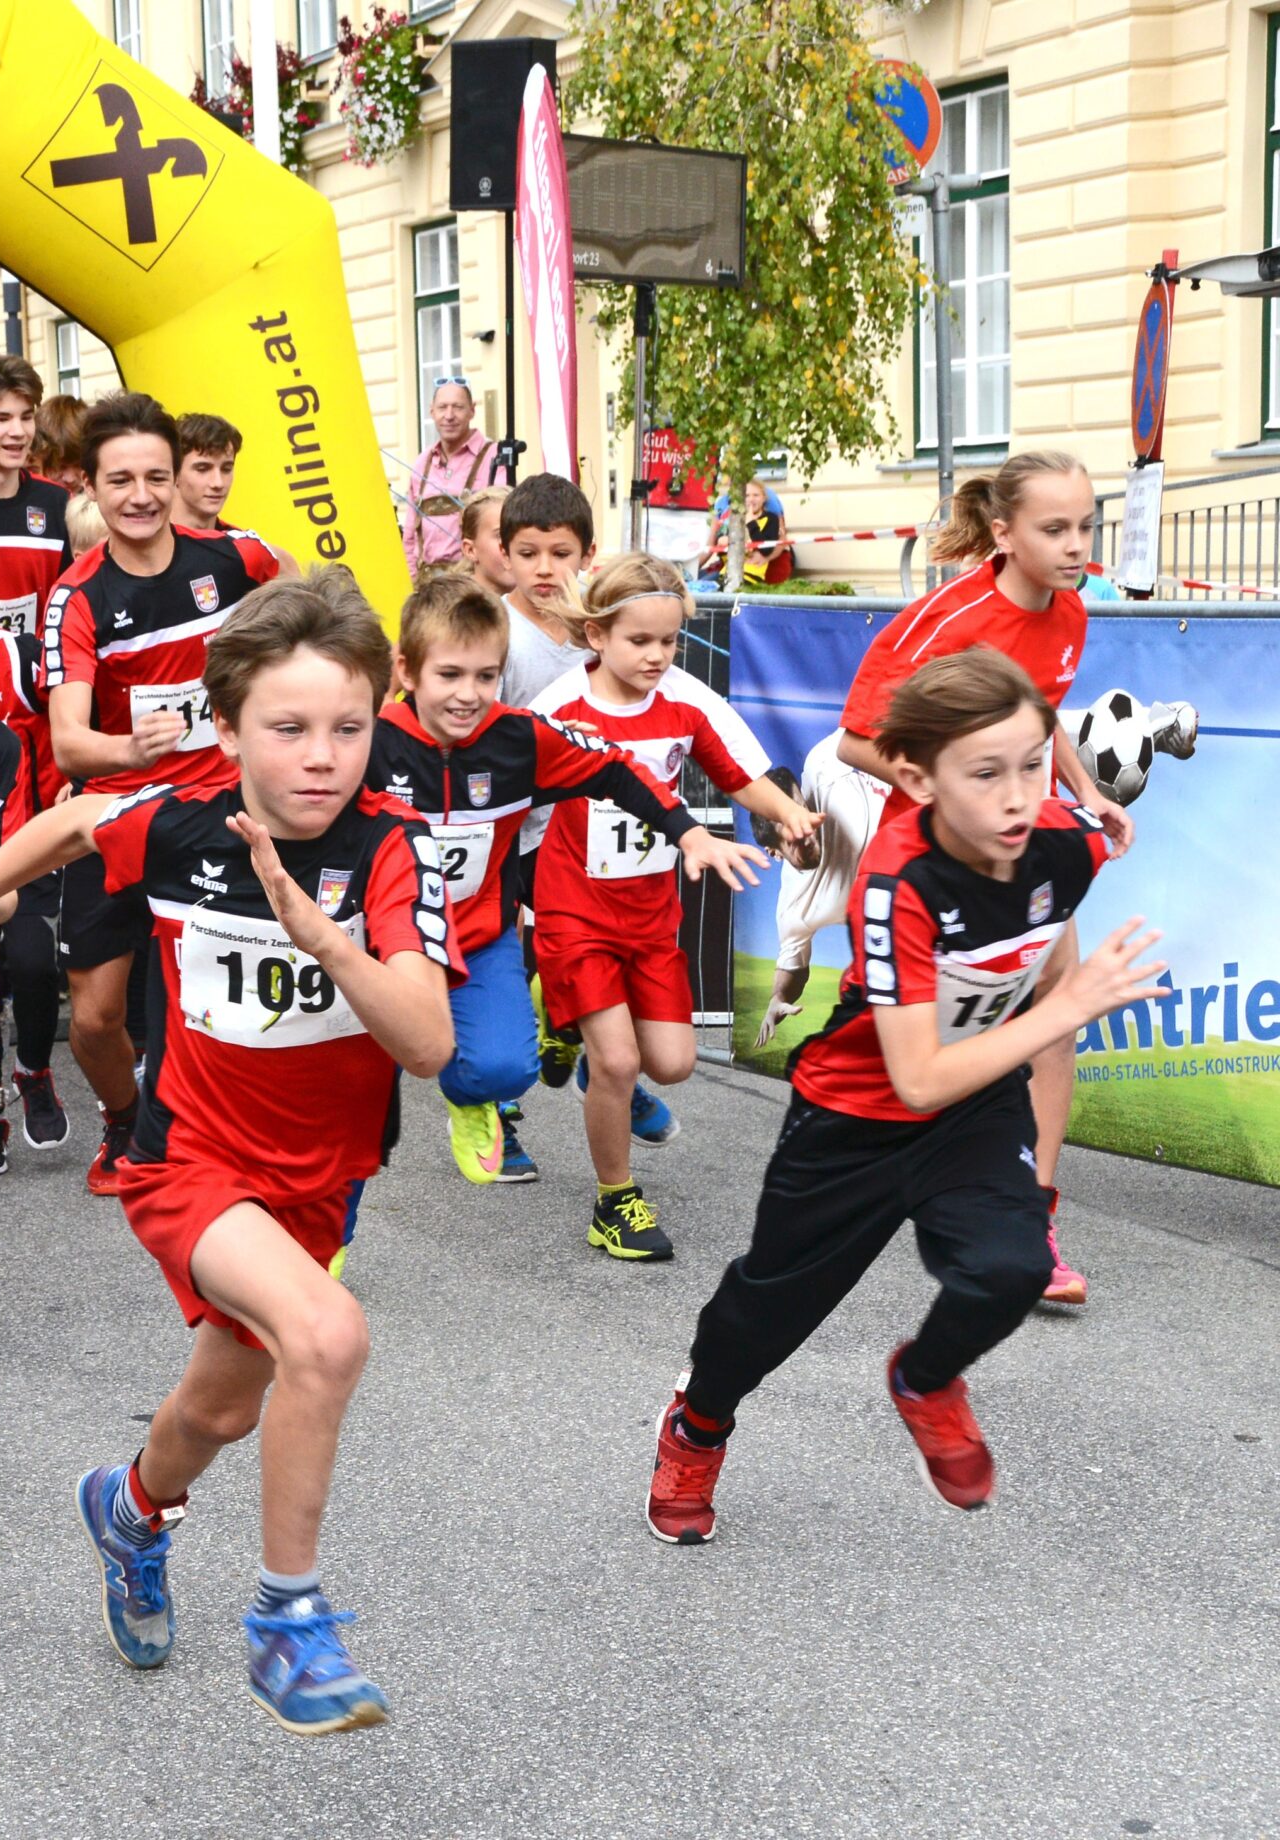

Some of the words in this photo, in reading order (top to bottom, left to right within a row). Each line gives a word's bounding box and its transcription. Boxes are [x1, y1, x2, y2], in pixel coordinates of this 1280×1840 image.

[248, 310, 355, 576] edling.at
[644, 432, 669, 448] Gut
[190, 874, 228, 894] erima
[190, 921, 268, 946] Perchtoldsdorfer
[216, 950, 336, 1014] 109
